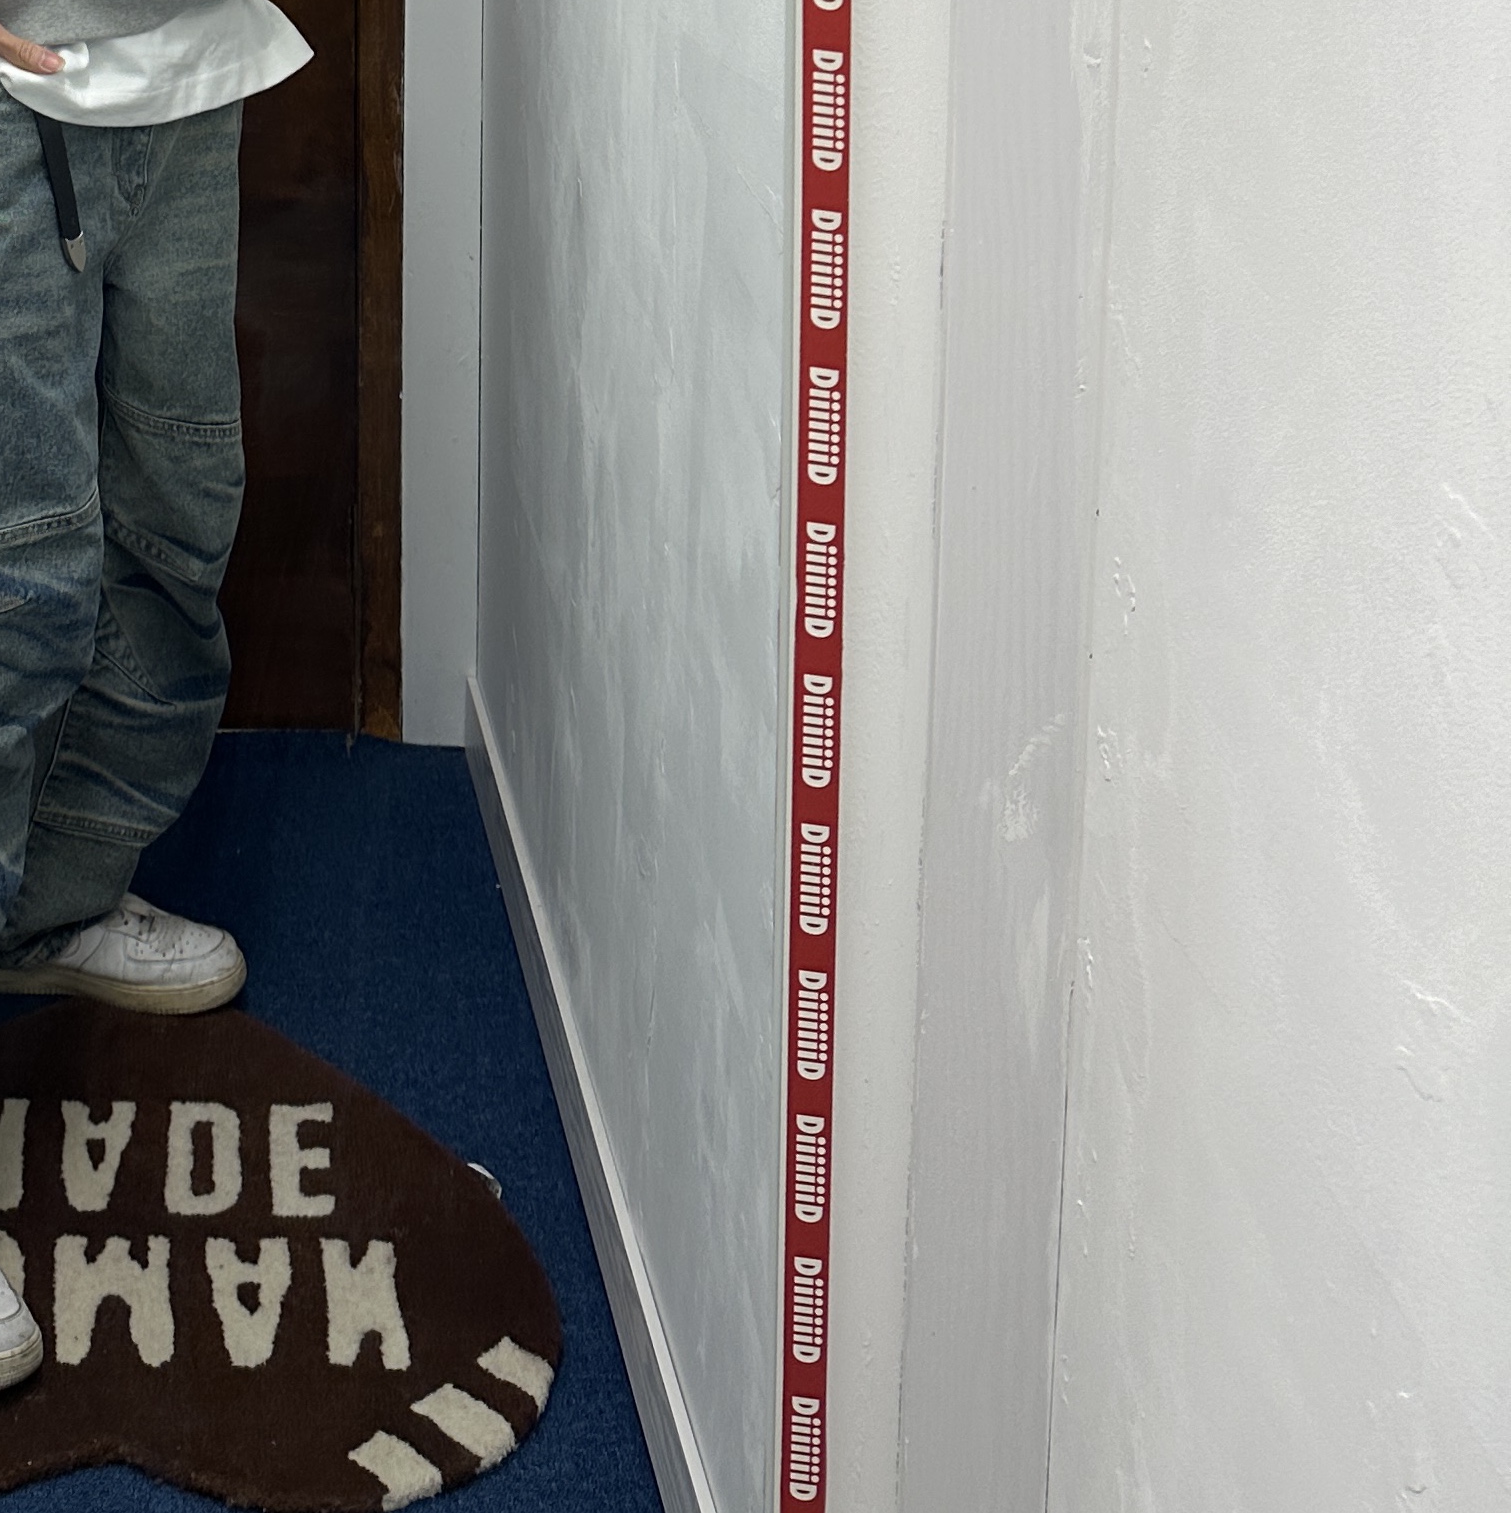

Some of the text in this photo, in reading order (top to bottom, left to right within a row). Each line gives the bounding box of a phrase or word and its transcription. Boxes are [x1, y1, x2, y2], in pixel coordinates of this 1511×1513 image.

[812, 49, 845, 171] DiiiiiiiD
[810, 209, 844, 329] DiiiiiiiD
[808, 367, 841, 485] DiiiiiiiD
[804, 522, 837, 638] DiiiiiiiD
[802, 674, 834, 787] DiiiiiiiD
[799, 823, 831, 935] DiiiiiiiD
[797, 970, 828, 1080] DiiiiiiiD
[795, 1114, 826, 1223] DiiiiiiiD
[793, 1257, 824, 1363] DiiiiiiiD
[790, 1396, 821, 1501] DiiiiiiiD
